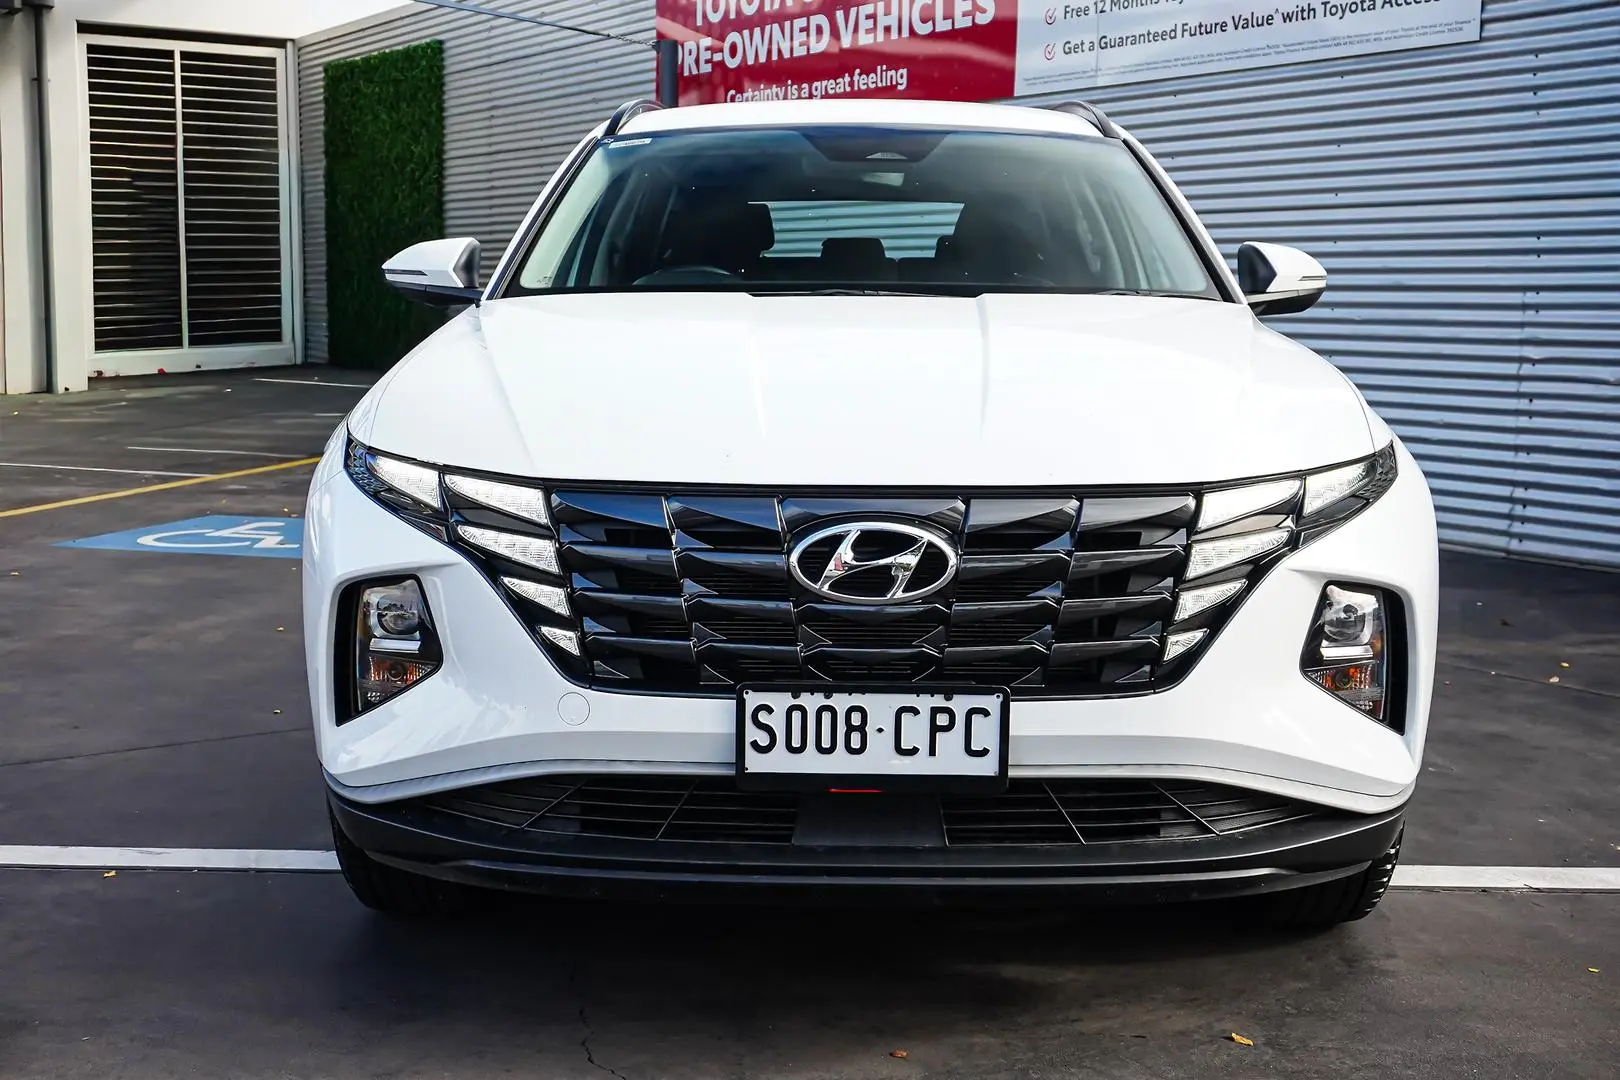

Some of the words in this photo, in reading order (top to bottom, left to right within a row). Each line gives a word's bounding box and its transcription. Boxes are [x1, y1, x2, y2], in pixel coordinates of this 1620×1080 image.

[1063, 5, 1090, 20] Free
[1093, 1, 1107, 14] 12
[1063, 39, 1085, 55] Get
[1088, 41, 1095, 52] a
[1098, 24, 1178, 51] Guaranteed
[1181, 20, 1228, 38] Future
[1281, 2, 1316, 24] with
[1321, 0, 1376, 20] Toyota
[678, 13, 831, 77] RE-OWNED
[836, 0, 996, 49] VEHICLES
[727, 82, 785, 103] Certainty
[787, 79, 799, 100] is
[801, 82, 810, 98] a
[812, 72, 851, 100] great
[853, 64, 907, 91] feeling
[750, 703, 869, 756] S008
[894, 705, 992, 758] CPC
